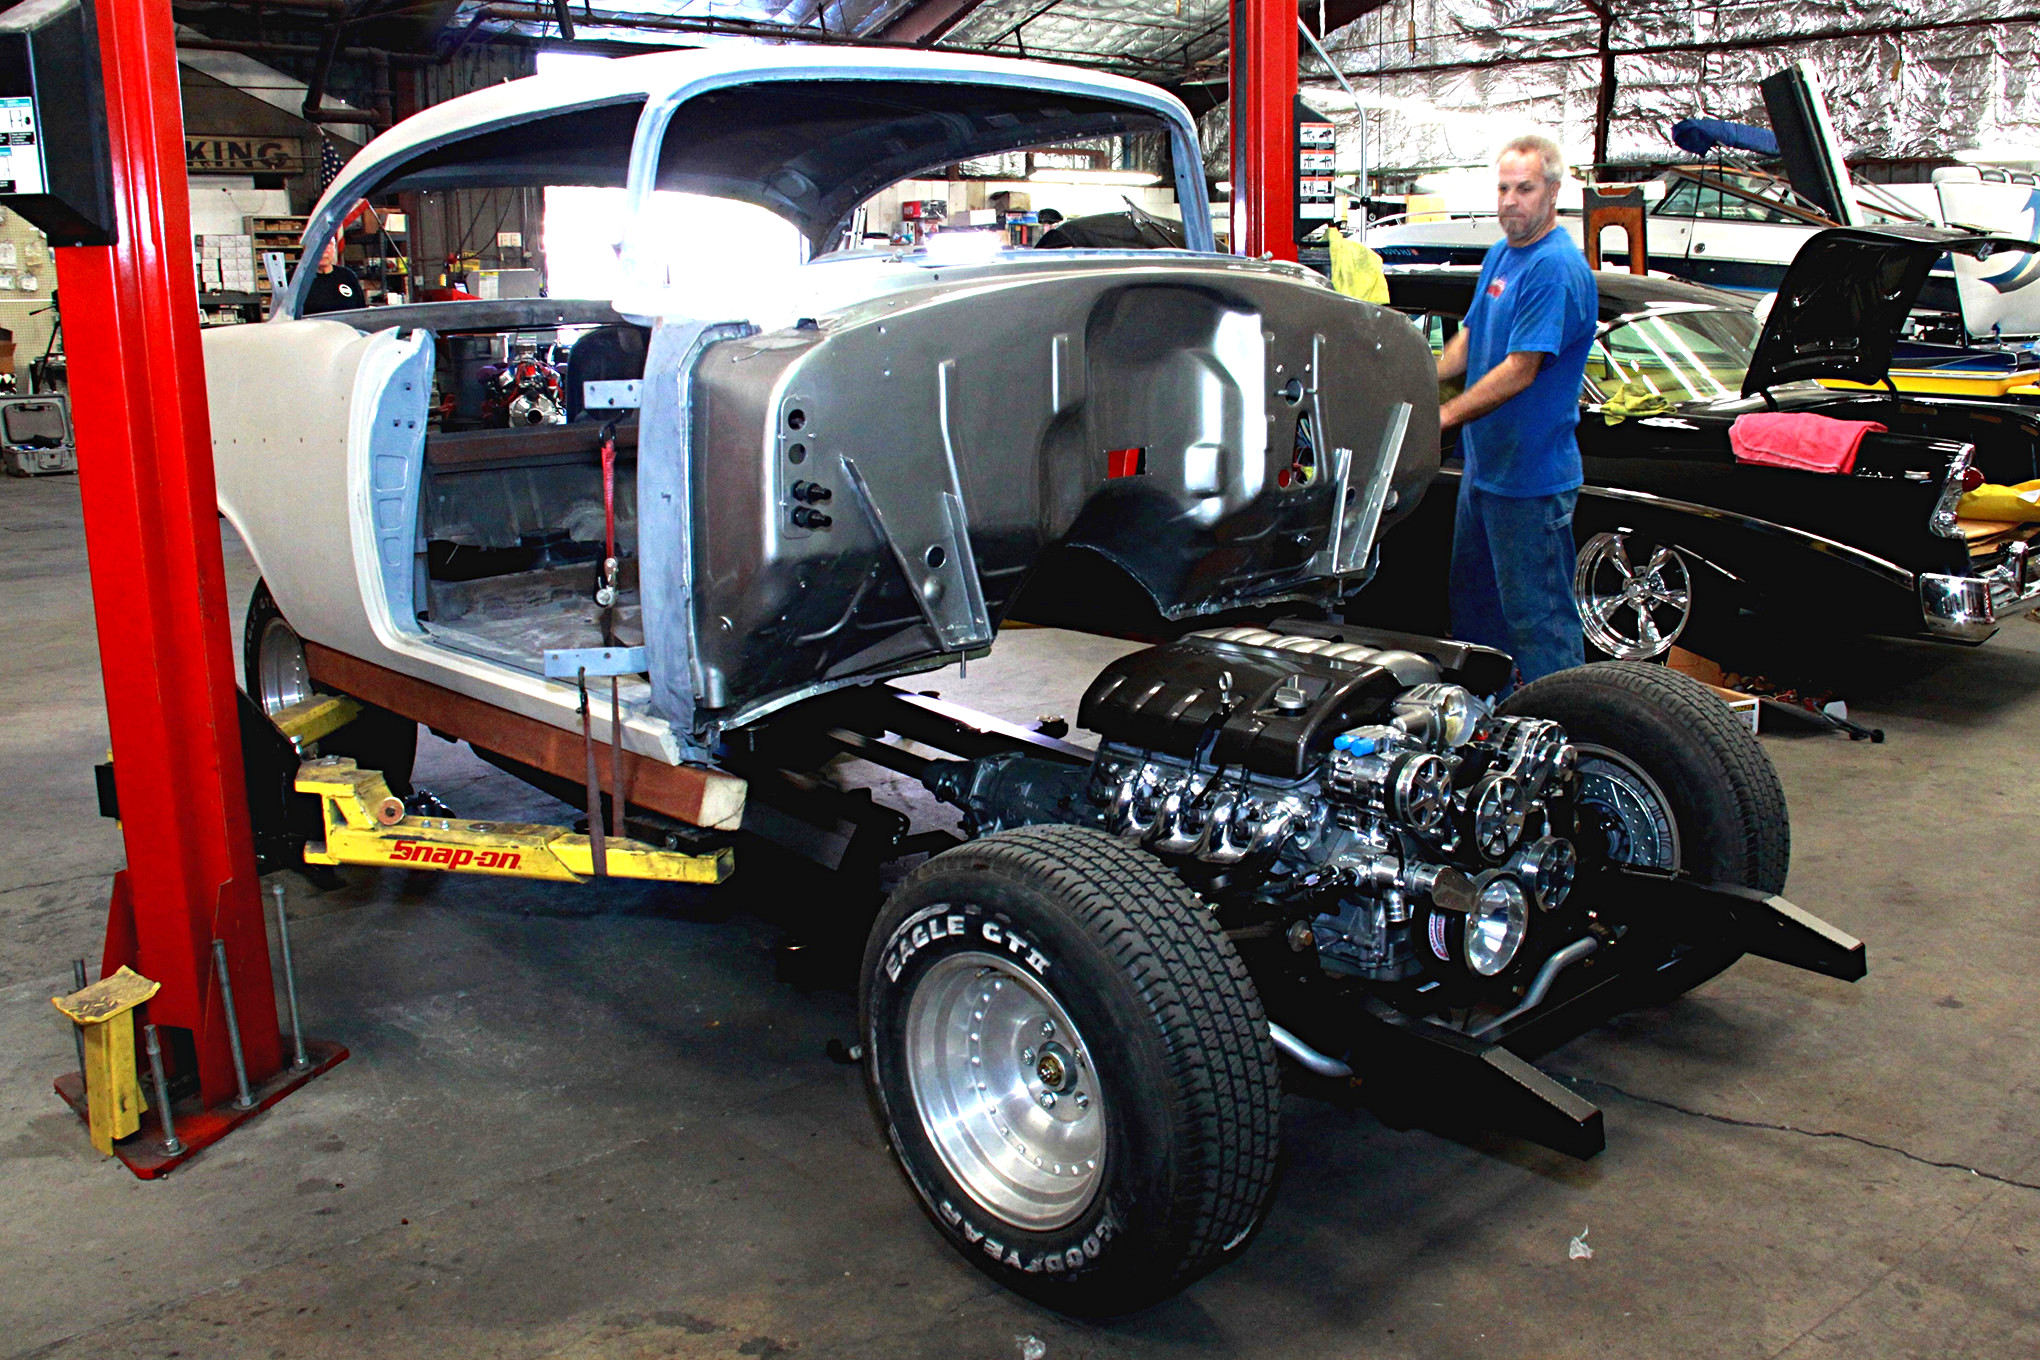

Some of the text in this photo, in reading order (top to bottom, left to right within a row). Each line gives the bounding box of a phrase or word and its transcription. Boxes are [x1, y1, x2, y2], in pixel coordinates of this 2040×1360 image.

[389, 839, 521, 869] Snap-on
[885, 914, 965, 983] EAGLE
[940, 1201, 1113, 1273] GOODYEAR
